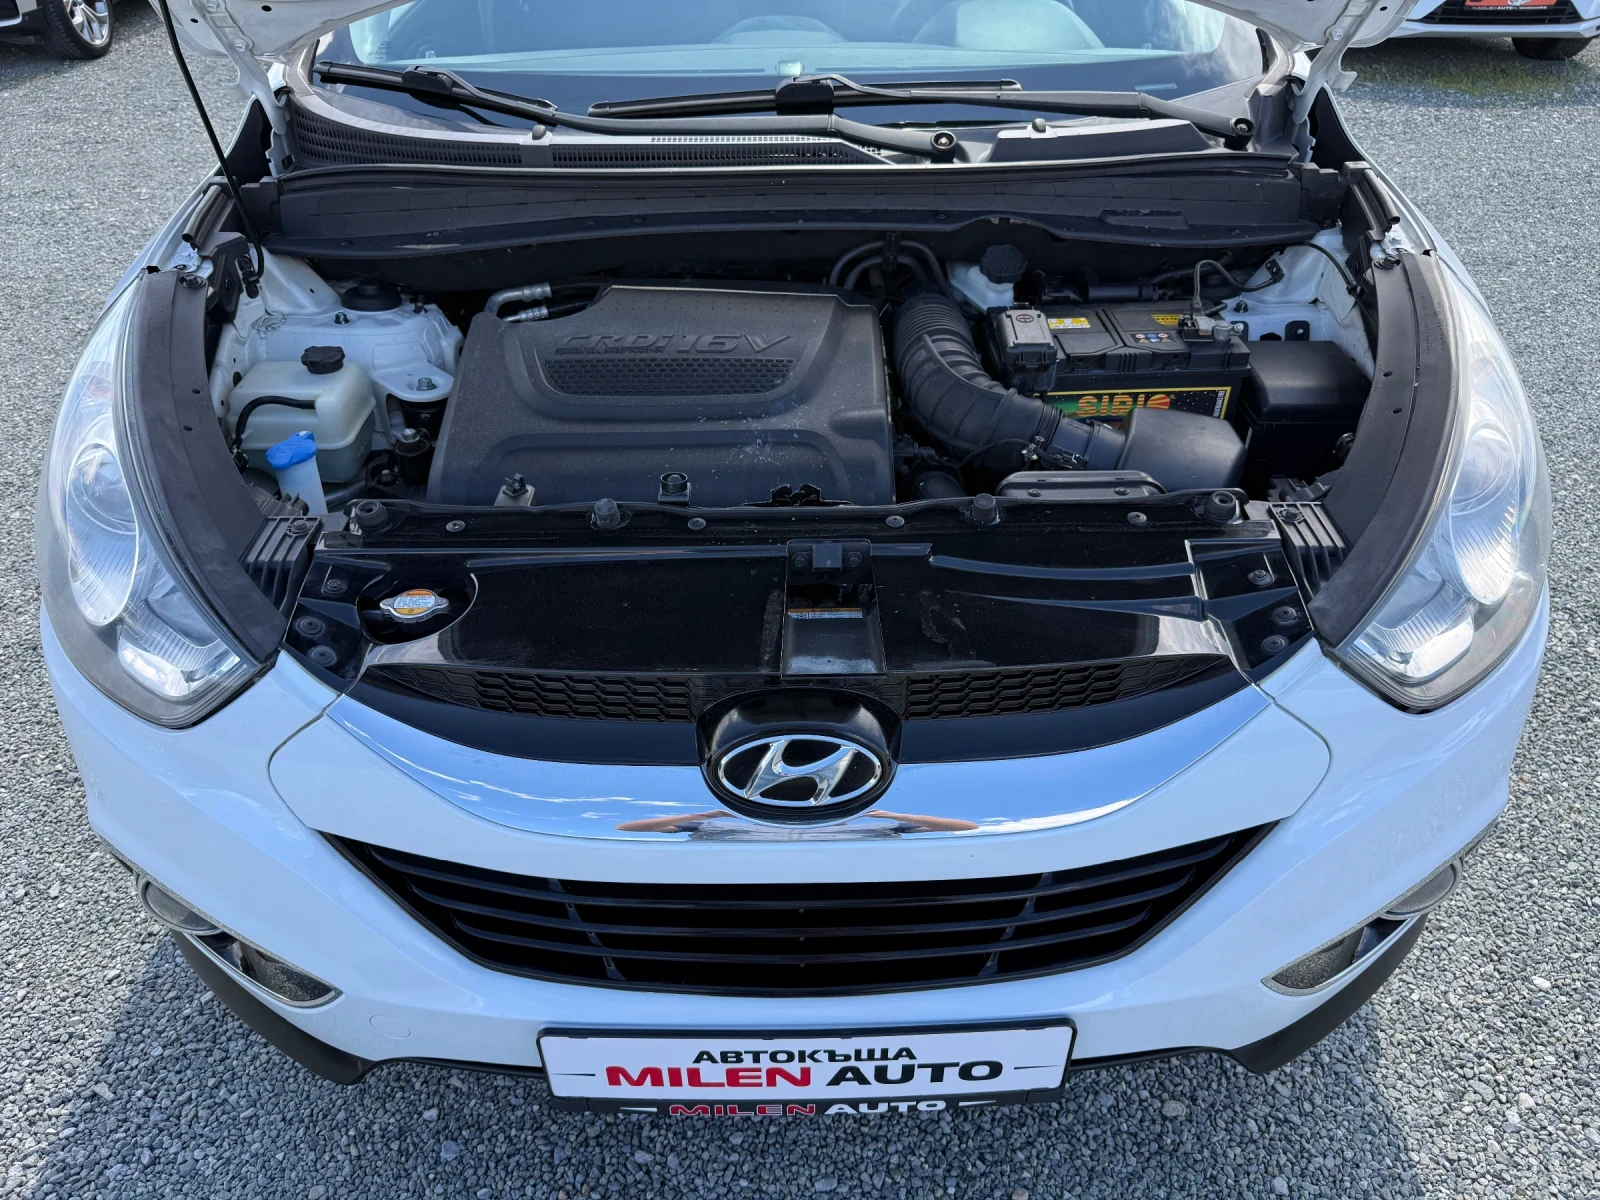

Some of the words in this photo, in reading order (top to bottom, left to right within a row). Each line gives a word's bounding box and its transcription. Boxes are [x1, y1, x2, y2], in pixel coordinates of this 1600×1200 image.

[692, 1047, 917, 1064] АВТОКЪЩА
[605, 1065, 811, 1088] MILEN
[825, 1060, 1004, 1086] AUTO
[669, 1104, 816, 1116] MILEN
[823, 1100, 947, 1115] AUTO
